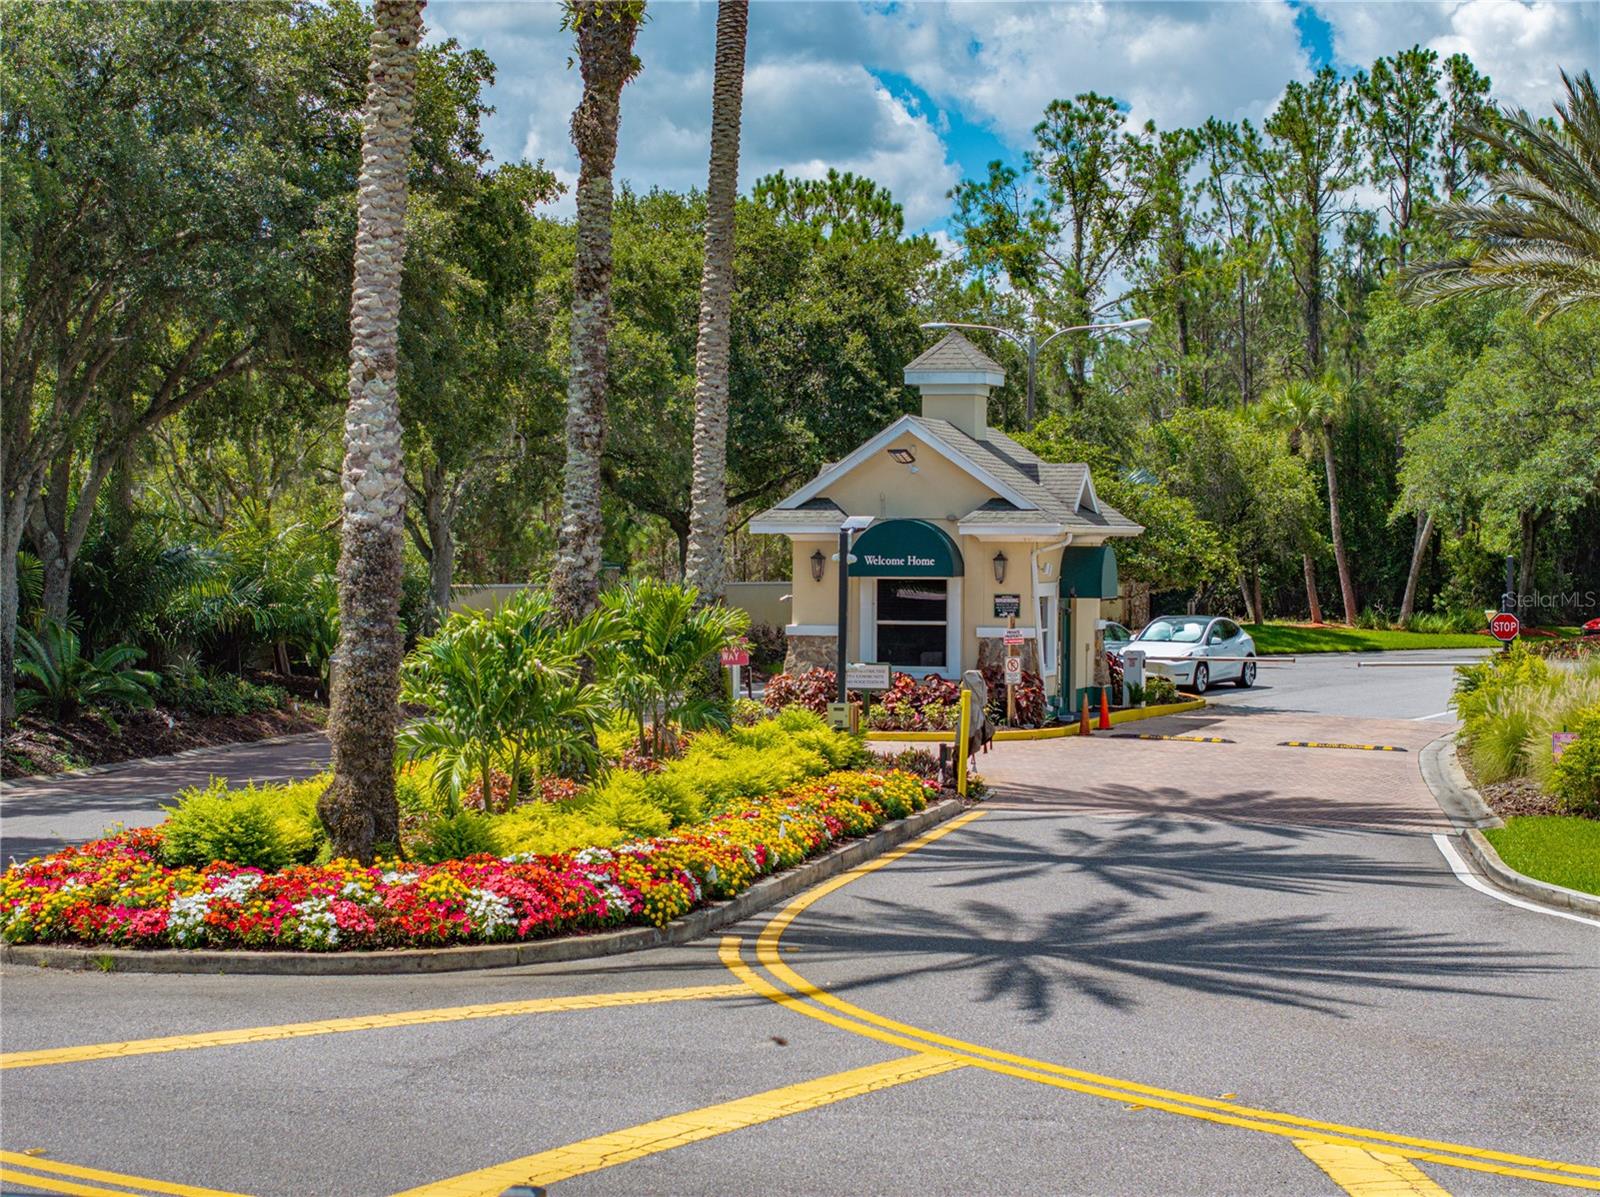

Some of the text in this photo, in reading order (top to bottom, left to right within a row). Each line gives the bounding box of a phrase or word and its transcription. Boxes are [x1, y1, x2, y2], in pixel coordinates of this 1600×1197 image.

[863, 555, 936, 566] Welcome Home
[1493, 621, 1517, 632] STOP
[722, 651, 740, 661] WAY
